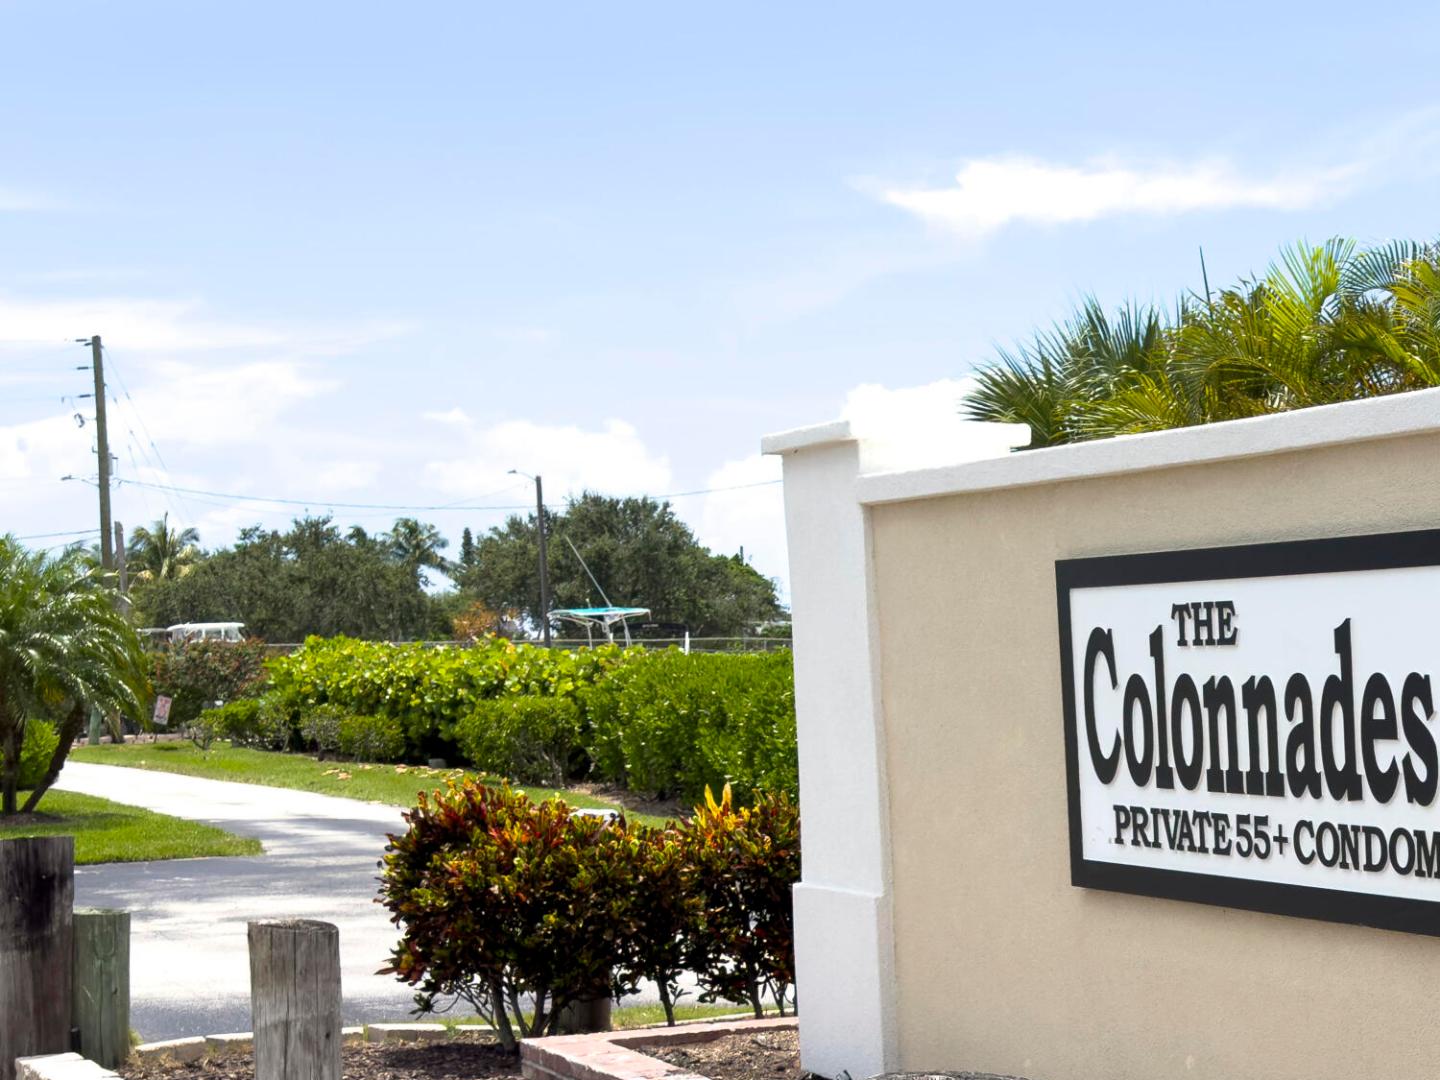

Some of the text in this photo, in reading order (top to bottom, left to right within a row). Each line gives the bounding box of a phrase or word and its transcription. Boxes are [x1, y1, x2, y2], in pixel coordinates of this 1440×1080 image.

[1171, 601, 1238, 647] THE
[1083, 617, 1439, 807] Colonnades
[1113, 804, 1232, 857] PRIVATE
[1236, 813, 1289, 860] 55+
